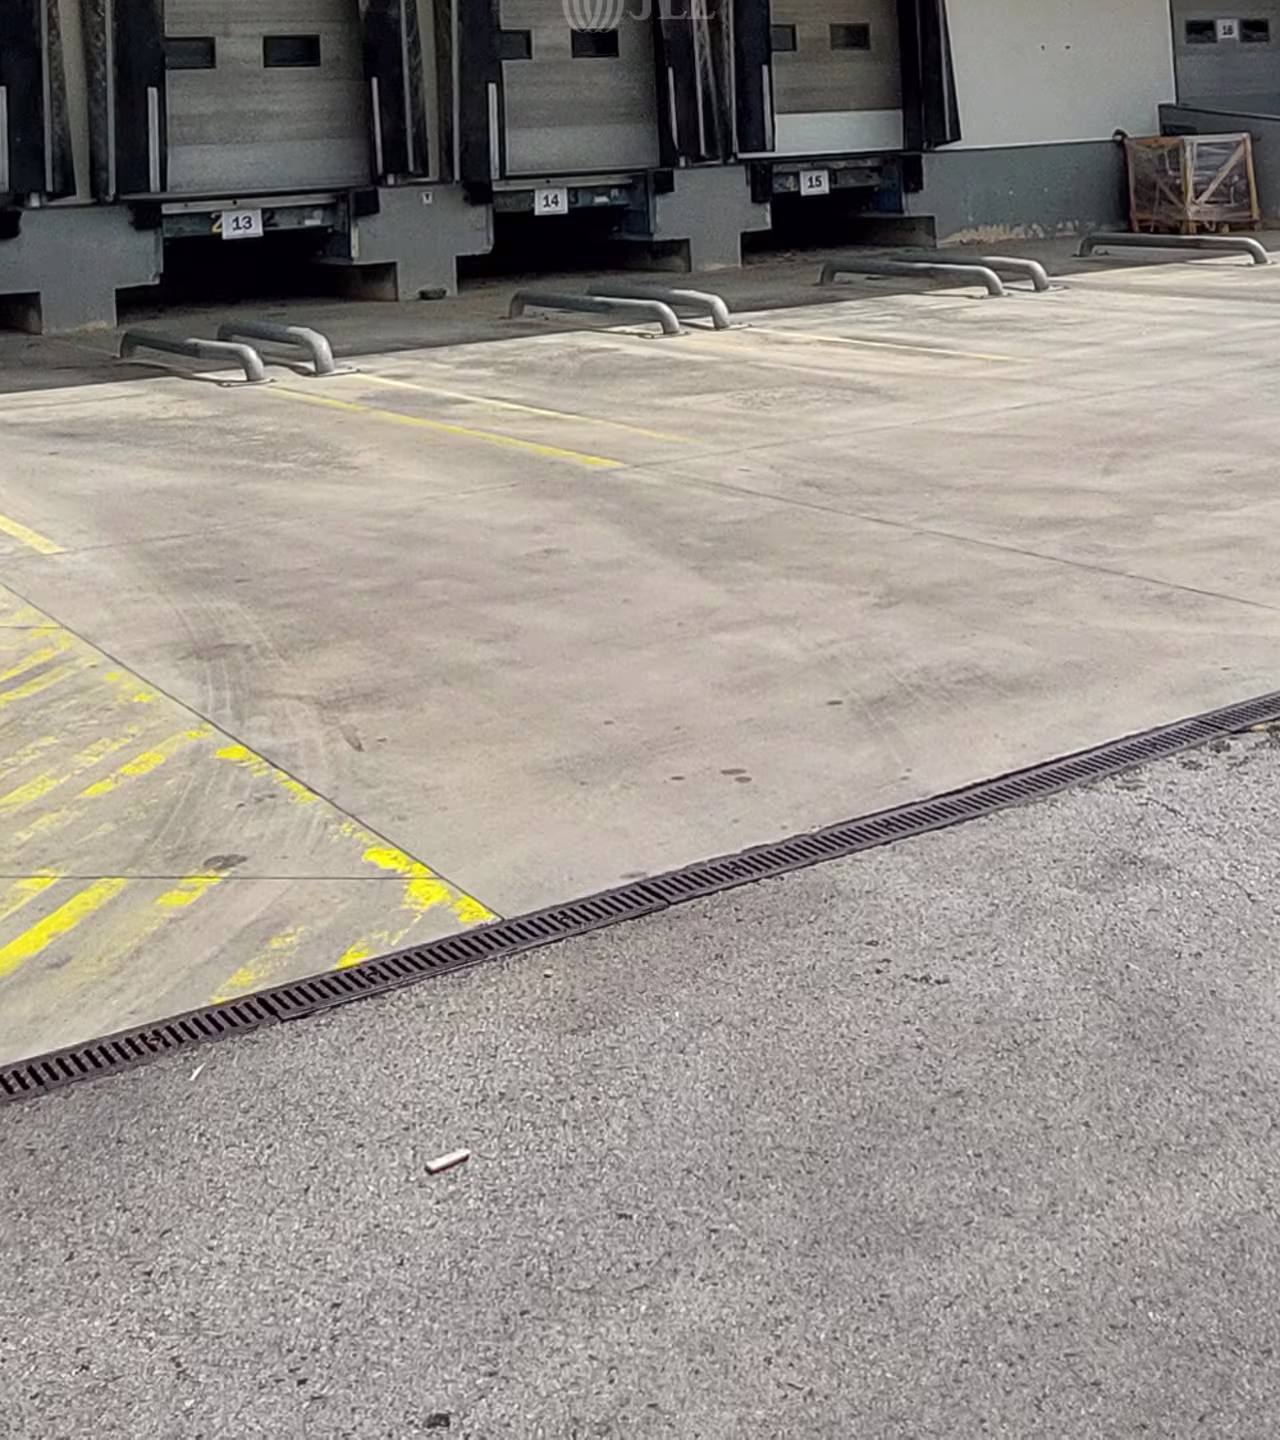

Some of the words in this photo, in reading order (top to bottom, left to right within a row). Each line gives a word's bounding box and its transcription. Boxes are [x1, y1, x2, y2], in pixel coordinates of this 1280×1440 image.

[807, 175, 823, 189] 15
[542, 193, 560, 208] 14
[231, 215, 253, 231] 13
